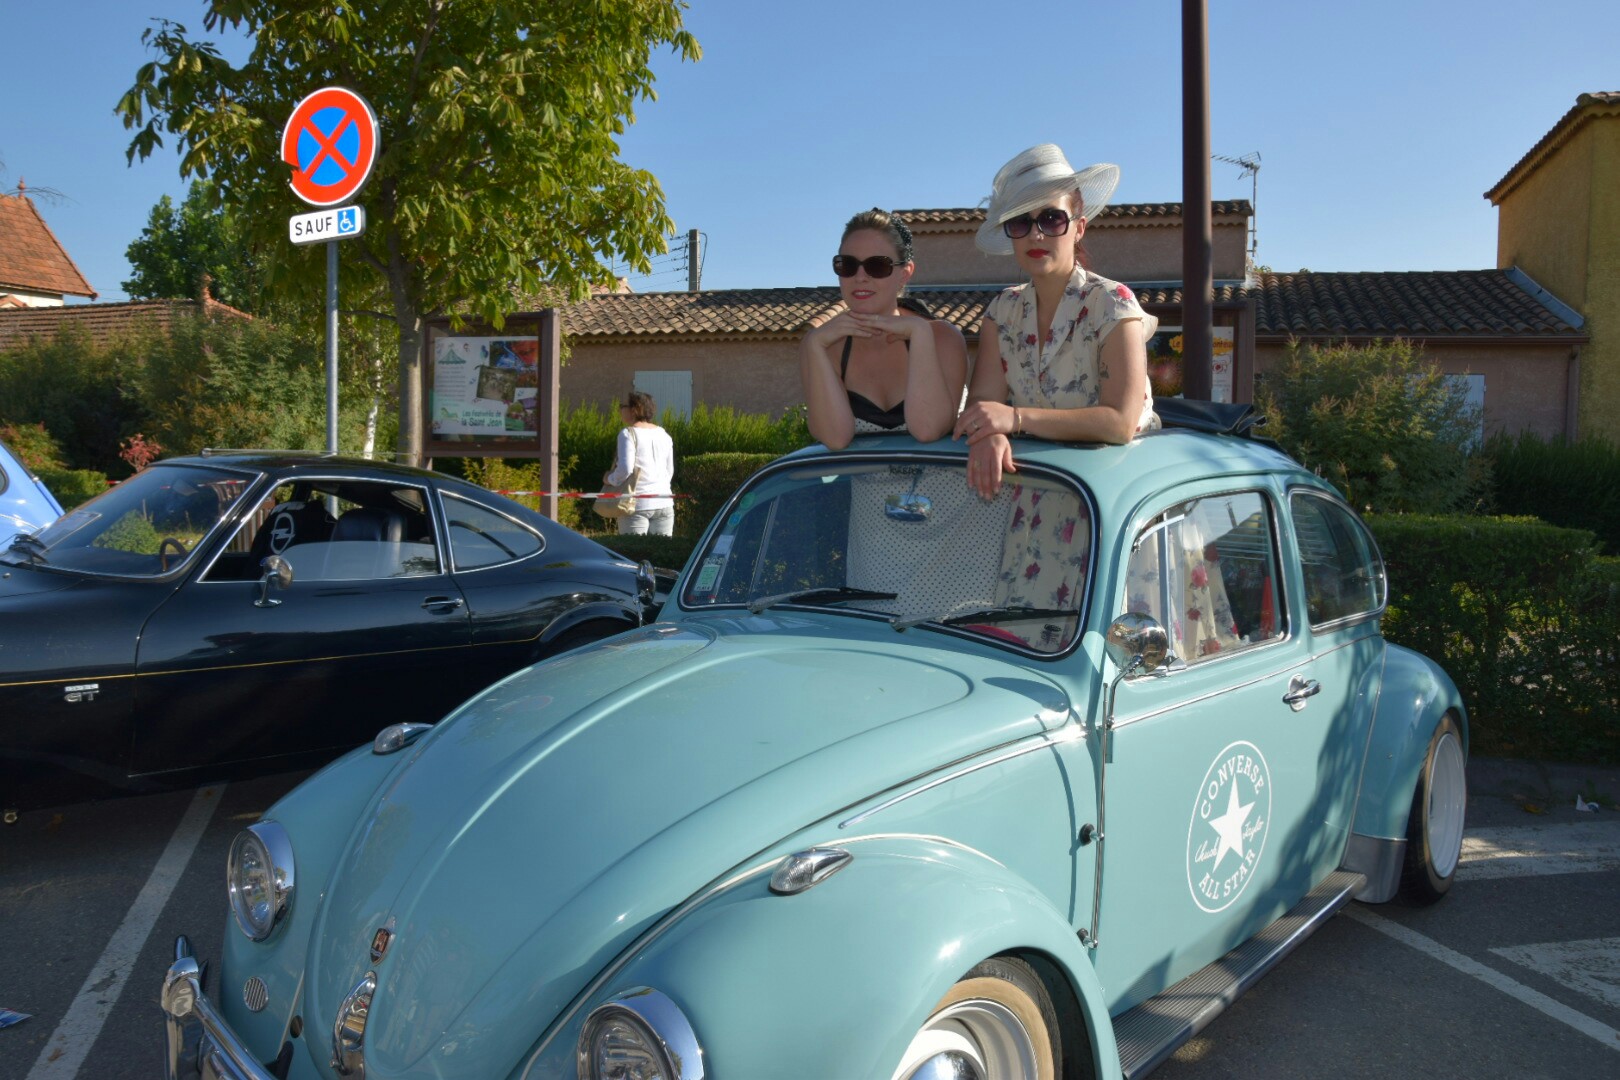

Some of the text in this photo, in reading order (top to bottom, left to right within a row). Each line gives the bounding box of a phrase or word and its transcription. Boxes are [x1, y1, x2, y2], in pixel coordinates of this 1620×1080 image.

[295, 216, 332, 236] SAUF
[469, 417, 485, 427] Saint
[487, 418, 503, 427] Jean
[64, 690, 99, 702] GT
[1200, 755, 1265, 819] CONVERSE
[1198, 849, 1256, 900] ALL STAR
